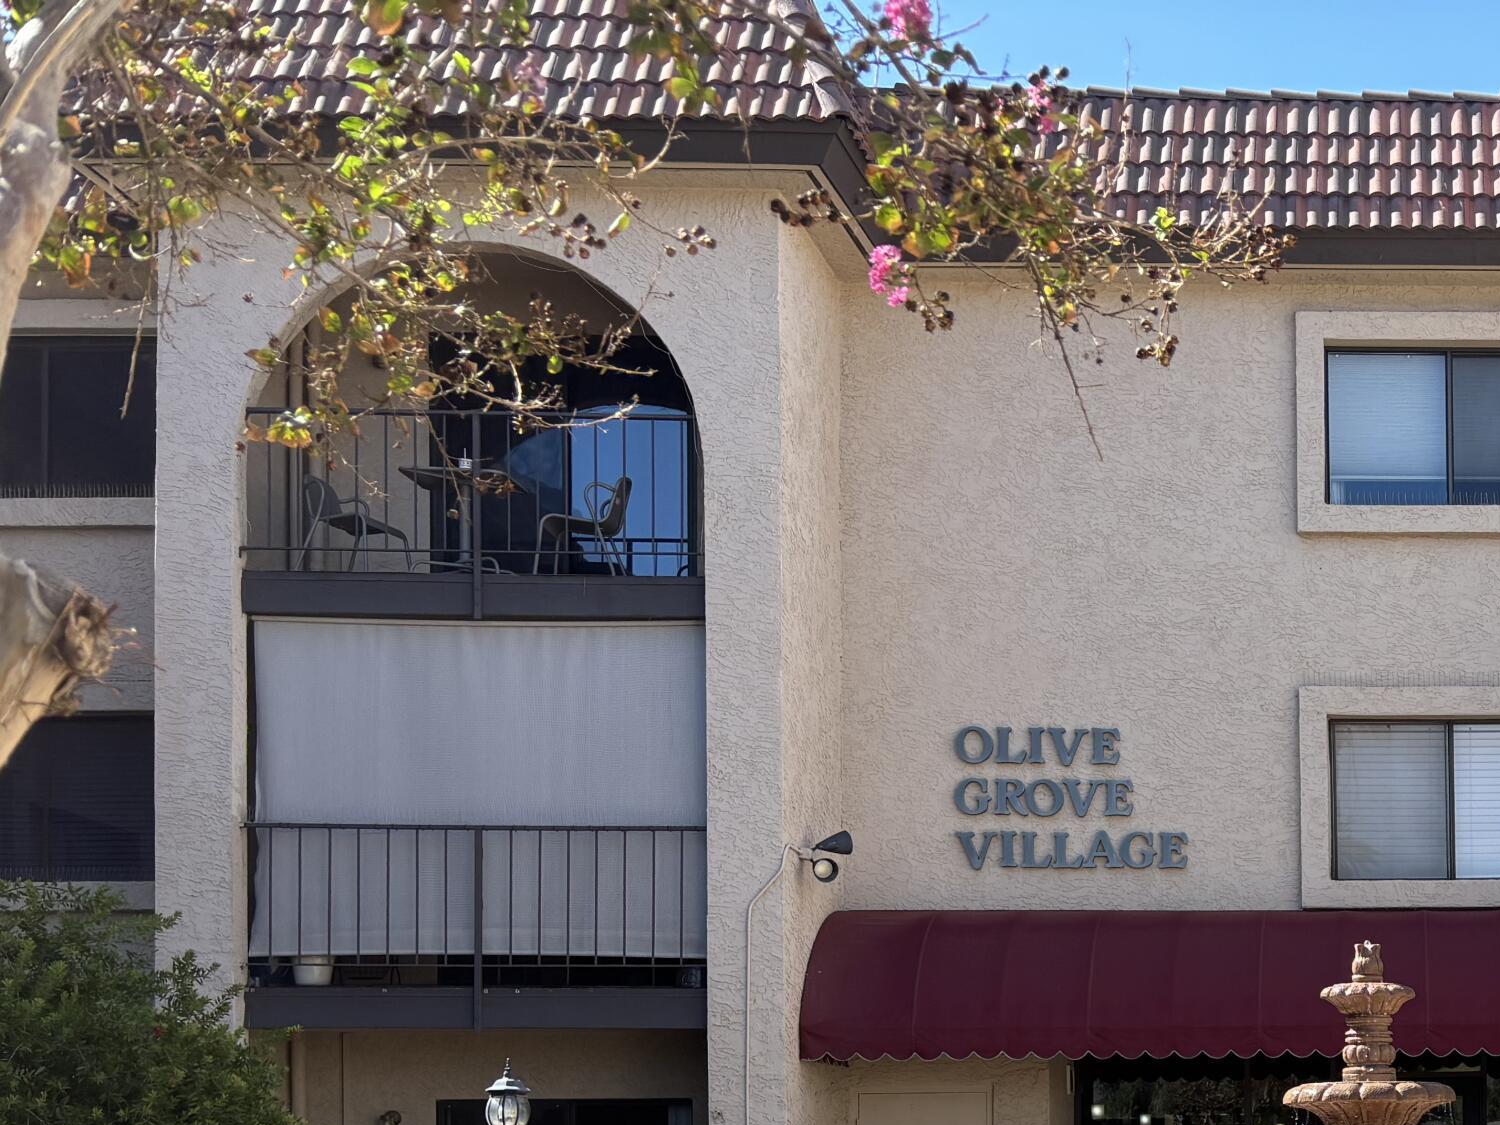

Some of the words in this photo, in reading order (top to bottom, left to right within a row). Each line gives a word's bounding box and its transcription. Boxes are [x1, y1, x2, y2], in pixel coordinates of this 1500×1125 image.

[954, 725, 1121, 767] OLIVE
[954, 777, 1134, 817] GROVE
[955, 830, 1189, 870] VILLAGE
